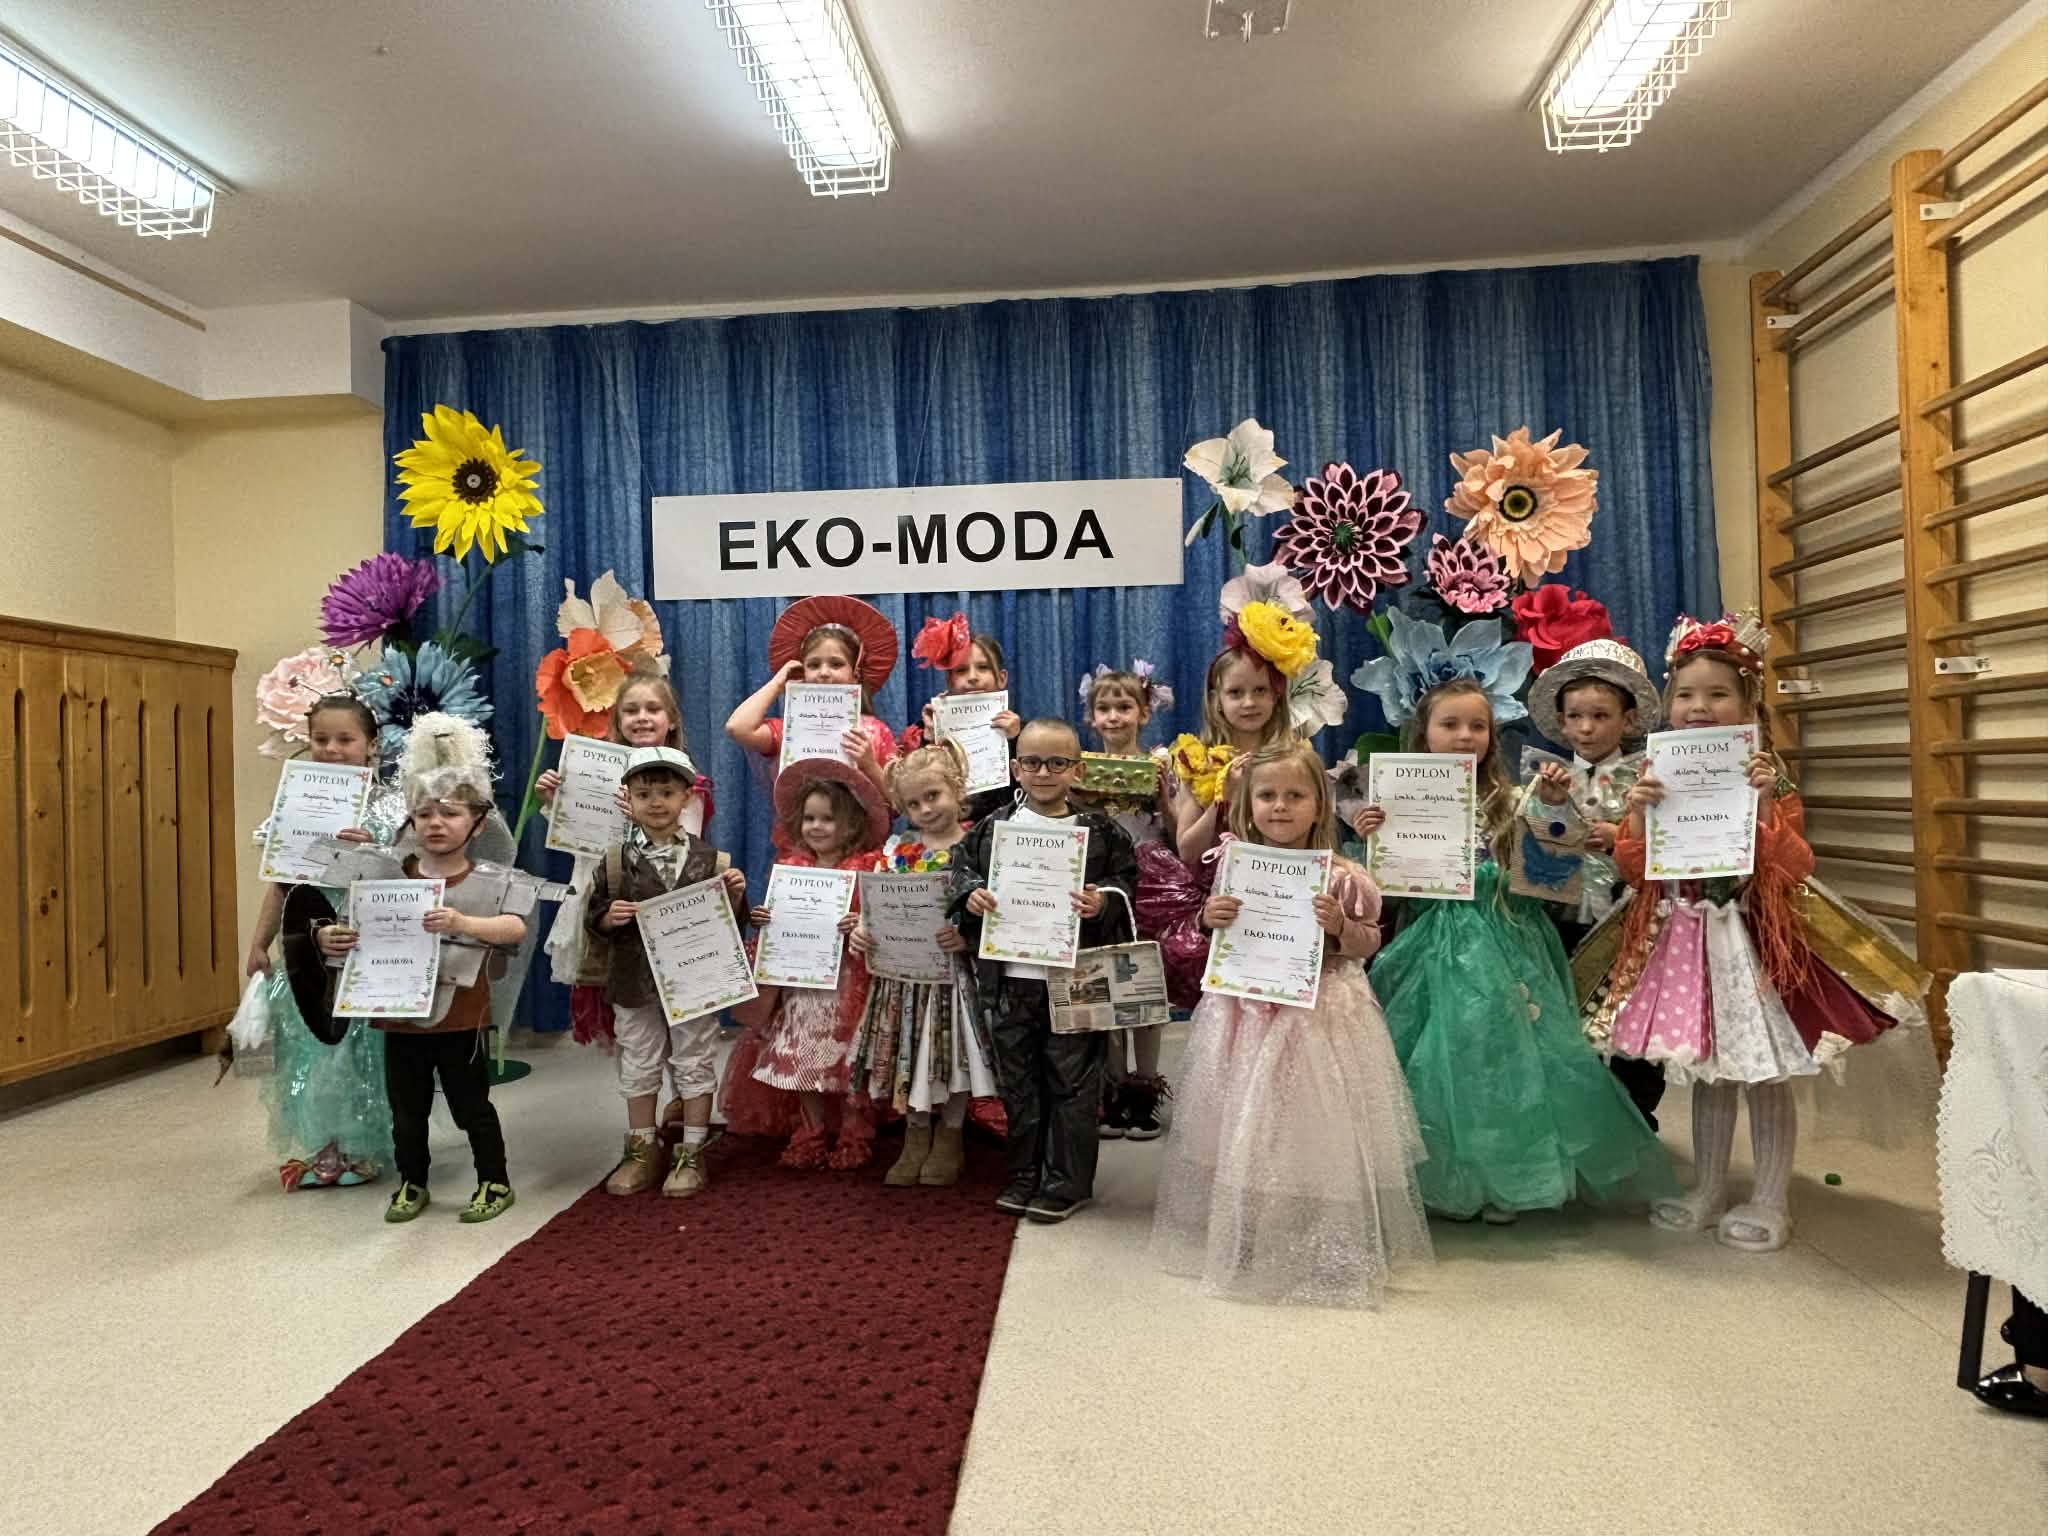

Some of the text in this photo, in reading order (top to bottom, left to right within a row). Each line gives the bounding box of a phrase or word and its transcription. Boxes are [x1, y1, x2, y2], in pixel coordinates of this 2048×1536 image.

[718, 509, 1114, 571] EKO-MODA
[804, 695, 843, 704] DYPLOM
[951, 704, 990, 714] DYPLOM
[1671, 742, 1729, 756] DYPLOM
[1395, 767, 1450, 779] DYPLOM
[303, 774, 350, 786] DYPLOM
[1677, 814, 1729, 823] EKO-MODA
[1016, 836, 1065, 849] DYPLOM
[1396, 832, 1447, 841] EKO-MODA
[1251, 859, 1307, 876] DYPLOM
[790, 877, 833, 889] DYPLOM
[881, 884, 929, 893] DYPLOM
[371, 893, 420, 903] DYPLOM
[1011, 898, 1056, 909] EKO-MODA
[658, 894, 706, 917] DYPLOM
[1244, 929, 1295, 943] EKO-MODA
